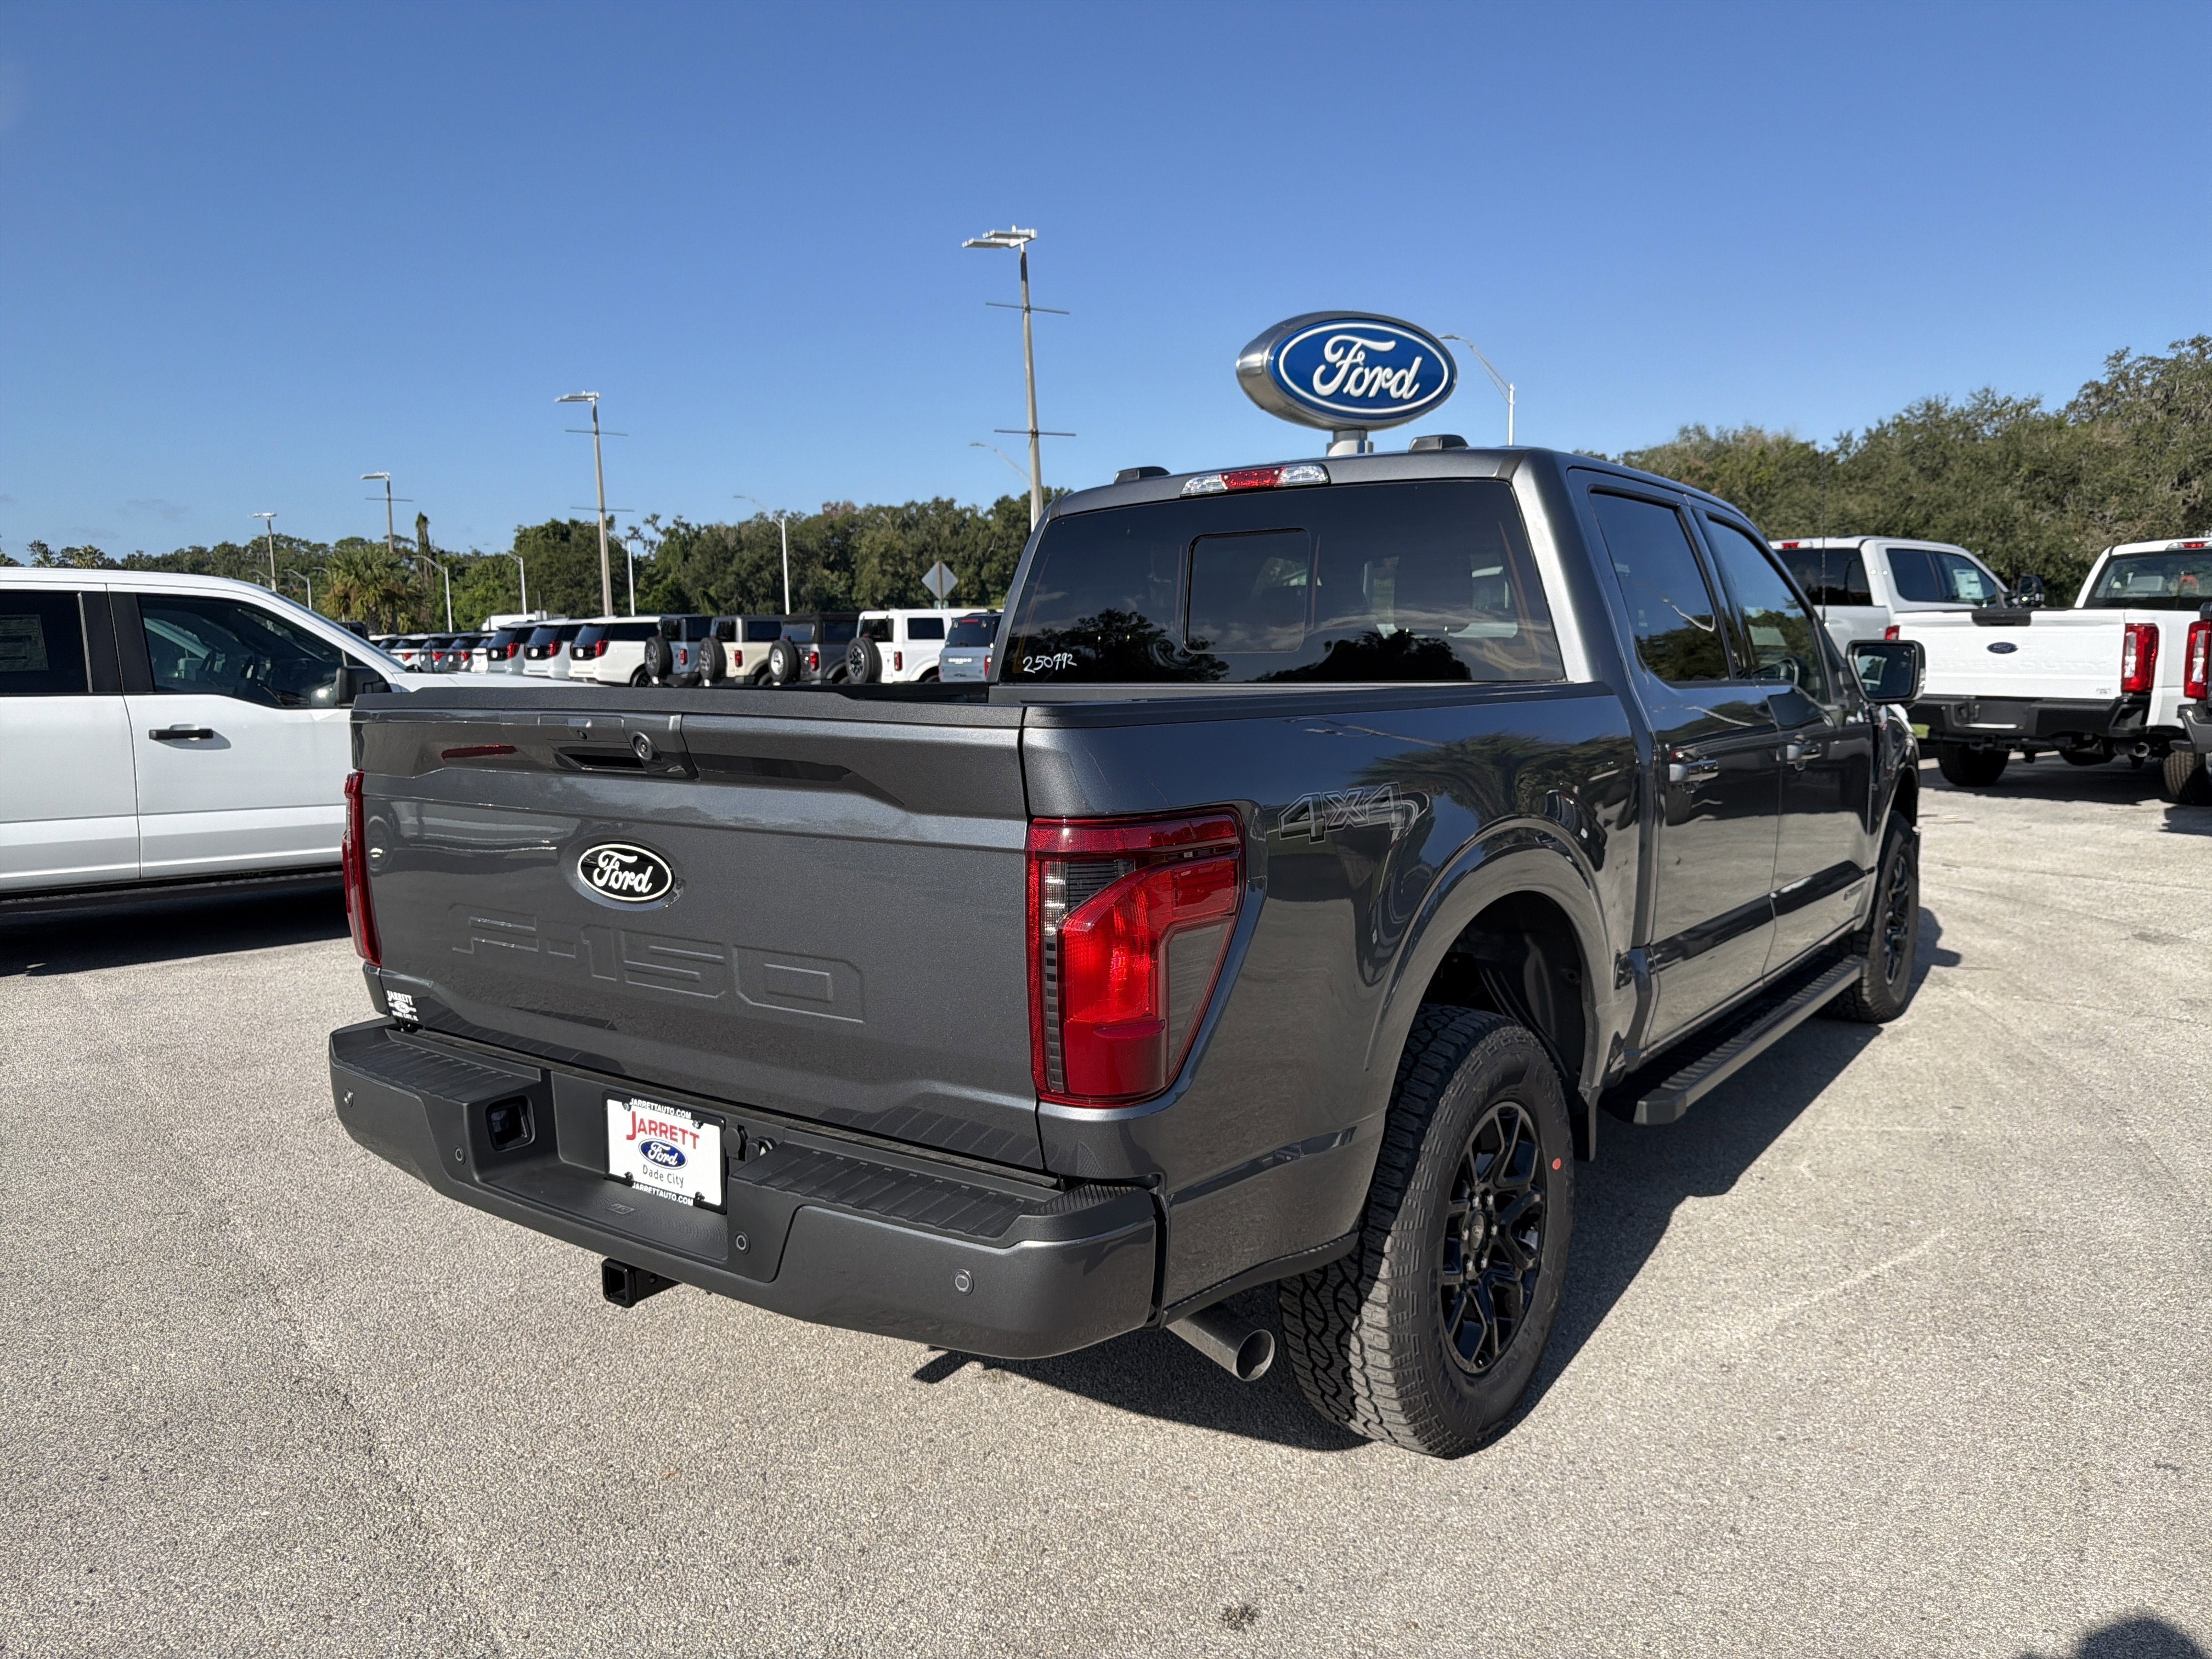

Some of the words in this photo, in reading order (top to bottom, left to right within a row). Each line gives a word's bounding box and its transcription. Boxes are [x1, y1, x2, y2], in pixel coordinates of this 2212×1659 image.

[1313, 335, 1422, 399] Ford
[1023, 653, 1077, 674] 250792
[593, 851, 653, 893] Ford
[447, 902, 865, 1023] F-150
[630, 1098, 691, 1119] JARRETTAUTO.COM
[626, 1111, 699, 1149] JARRETT
[648, 1142, 678, 1166] Ford
[642, 1164, 664, 1181] Dade
[667, 1173, 684, 1188] City
[632, 1182, 693, 1206] JARRETTAUTO.COM
